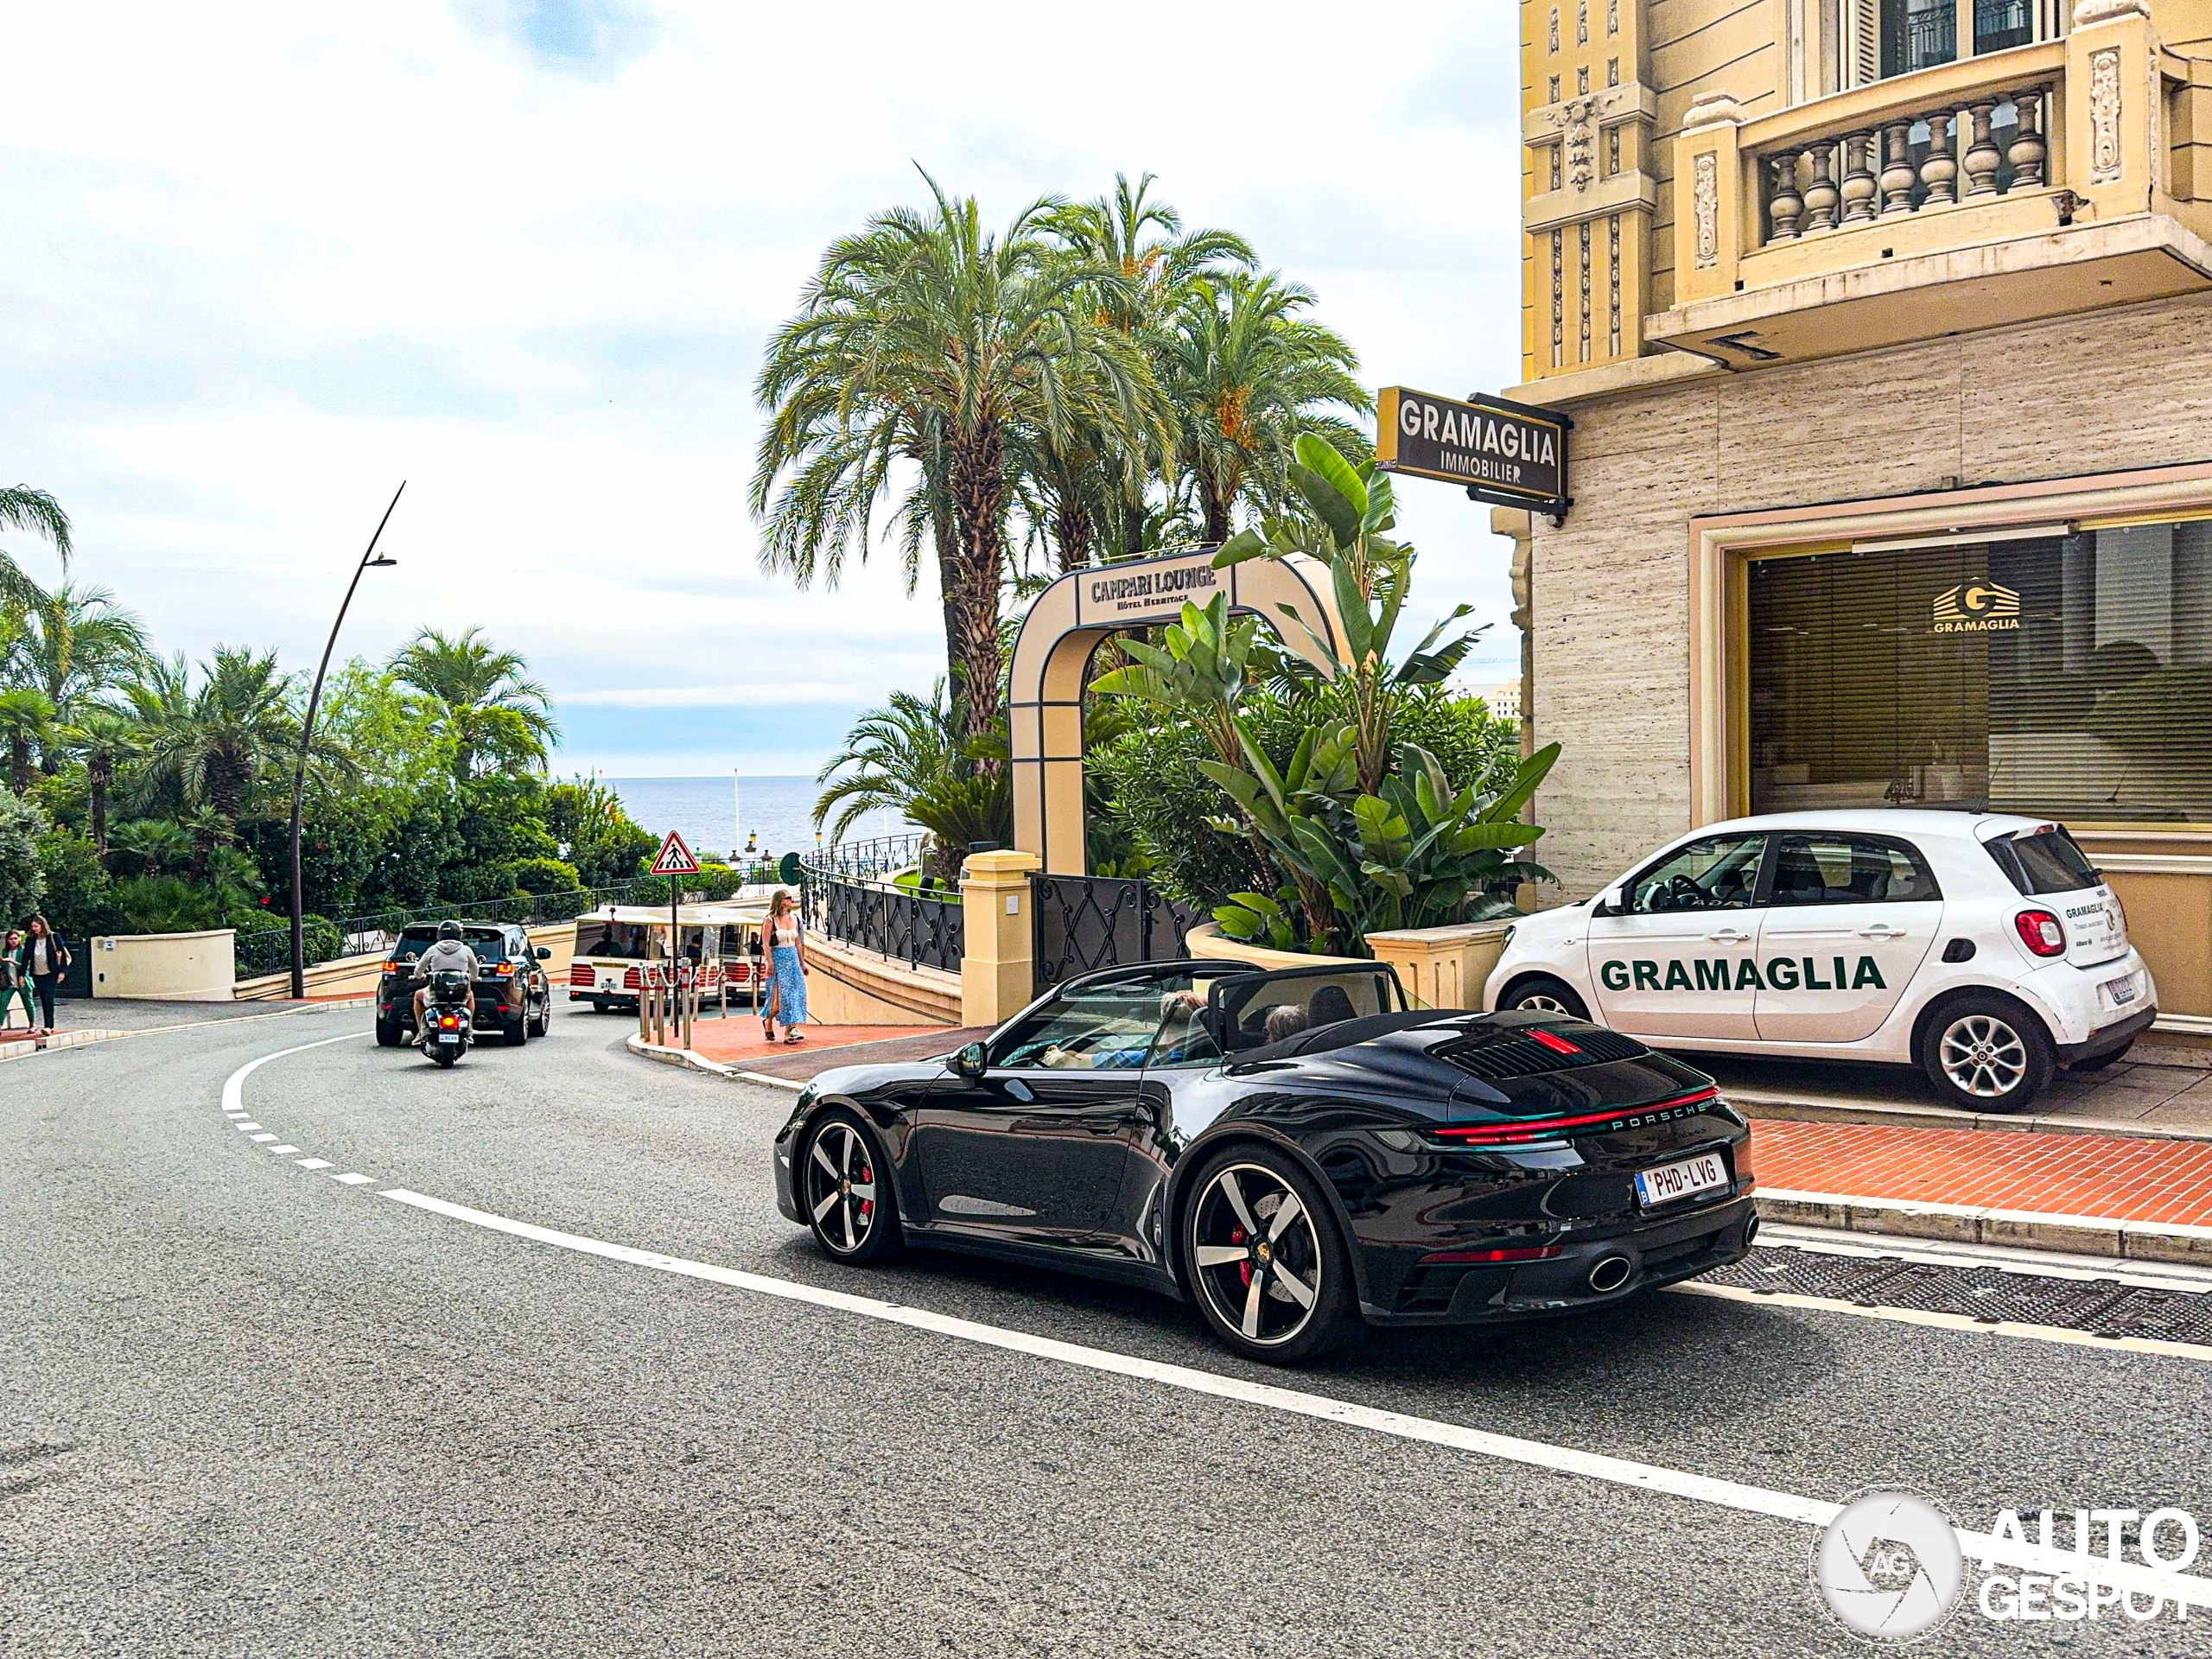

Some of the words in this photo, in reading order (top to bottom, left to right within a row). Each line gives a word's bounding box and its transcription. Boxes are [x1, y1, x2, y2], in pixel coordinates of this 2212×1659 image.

[1401, 399, 1555, 467] GRAMAGLIA
[1440, 450, 1521, 484] IMMOBILIER
[1091, 575, 1153, 603] CAMPARI
[1155, 565, 1216, 594] LOUNGE
[1934, 619, 2020, 633] GRAMAGLIA
[2066, 902, 2104, 918] GRAMAGLIA
[1600, 956, 1887, 991] GRAMAGLIA
[1611, 1103, 1707, 1131] PORSCHE
[1641, 1191, 1649, 1202] B
